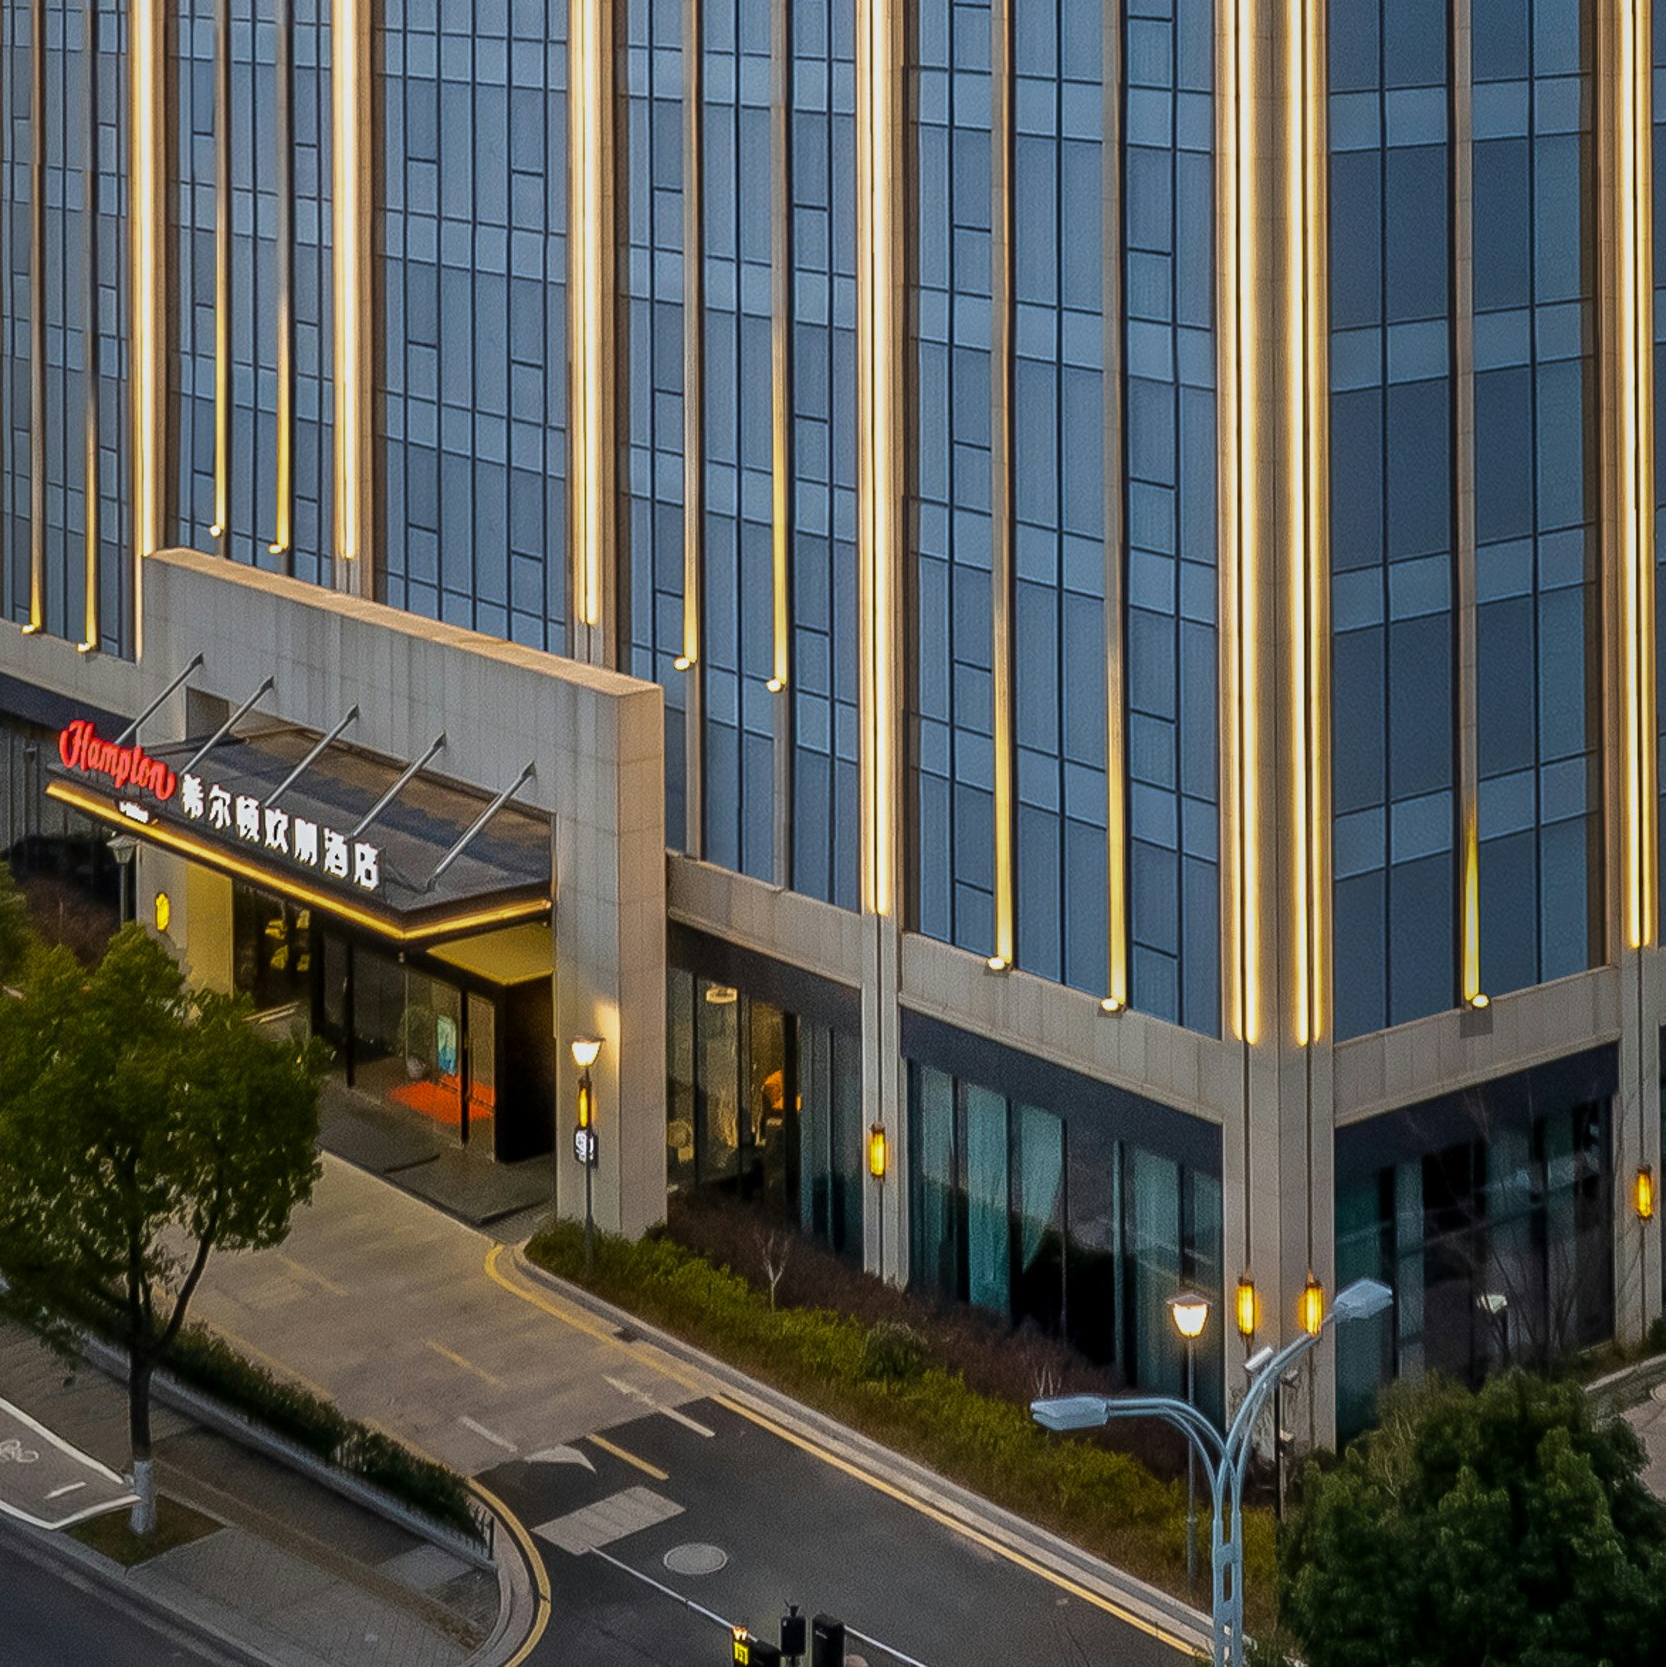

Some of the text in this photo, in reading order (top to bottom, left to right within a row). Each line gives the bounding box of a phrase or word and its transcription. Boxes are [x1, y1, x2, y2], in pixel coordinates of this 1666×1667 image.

[59, 720, 177, 801] Hampton
[182, 773, 380, 892] 希尔顿欢朋酒店
